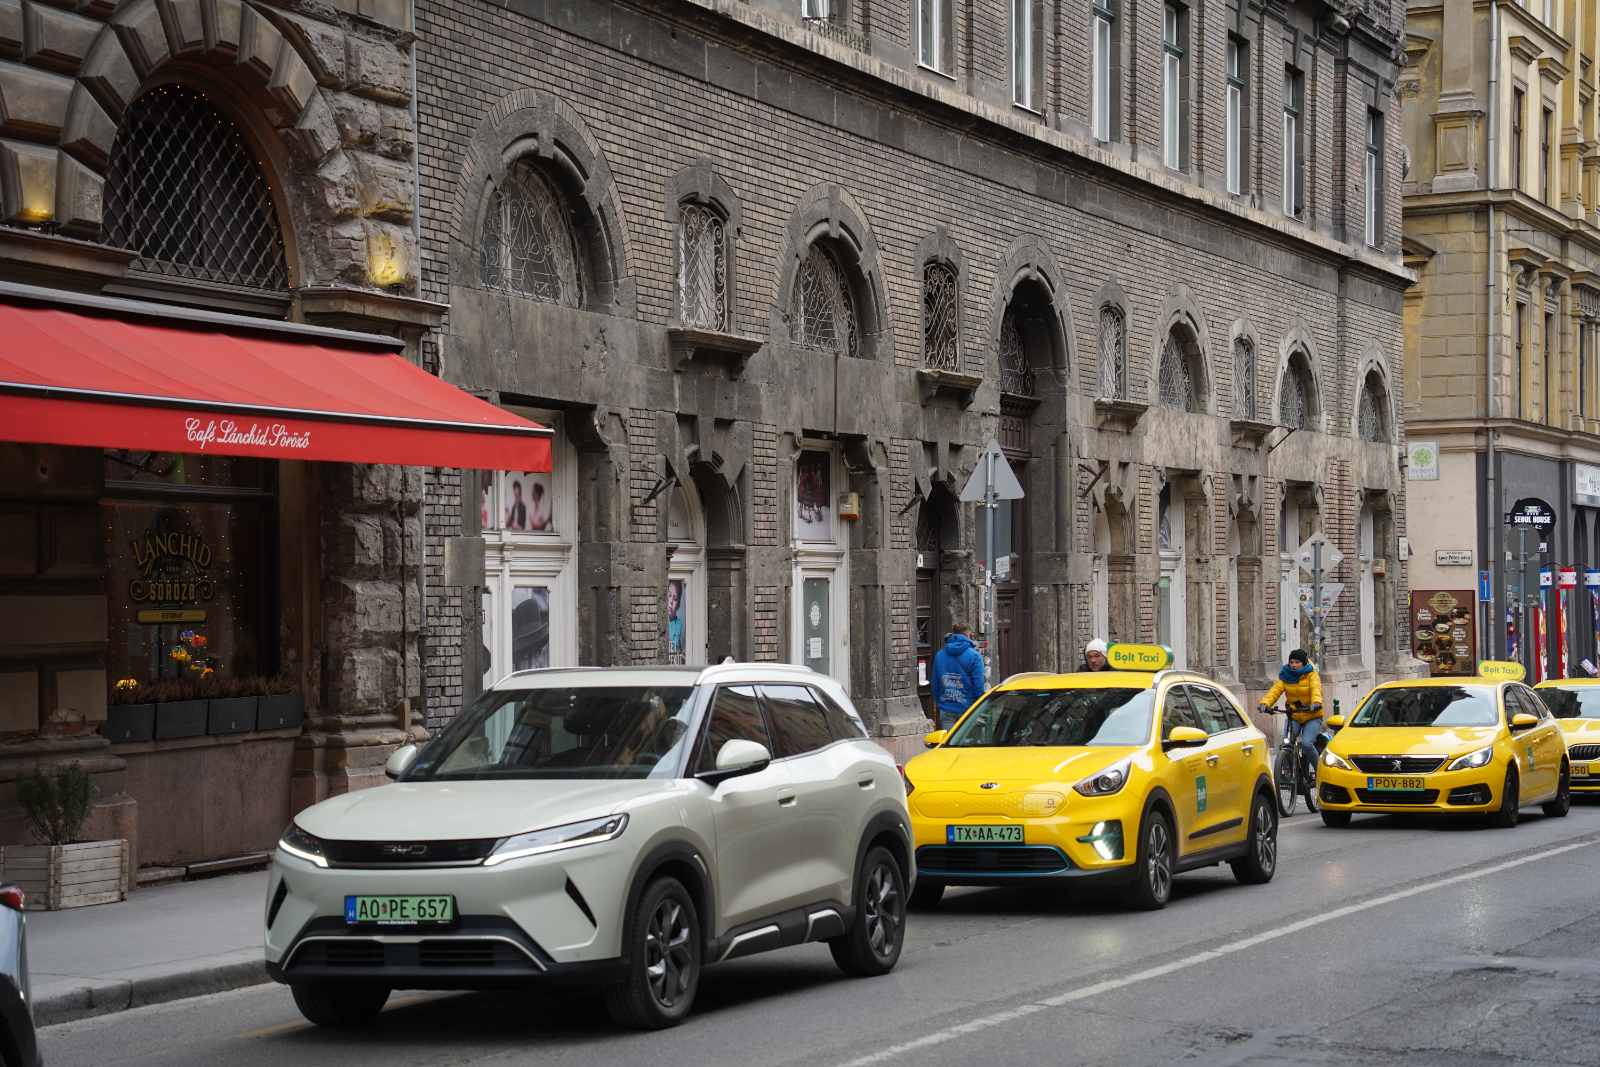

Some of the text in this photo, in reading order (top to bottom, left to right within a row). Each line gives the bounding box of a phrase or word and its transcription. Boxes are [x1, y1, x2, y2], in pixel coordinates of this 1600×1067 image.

[185, 417, 311, 449] Café Lánchíd Söröző
[1514, 515, 1551, 524] SEOUL HOUSE
[1114, 651, 1160, 663] Bolt Taxi
[957, 827, 1022, 841] TX AA-473
[388, 899, 449, 919] PE-657
